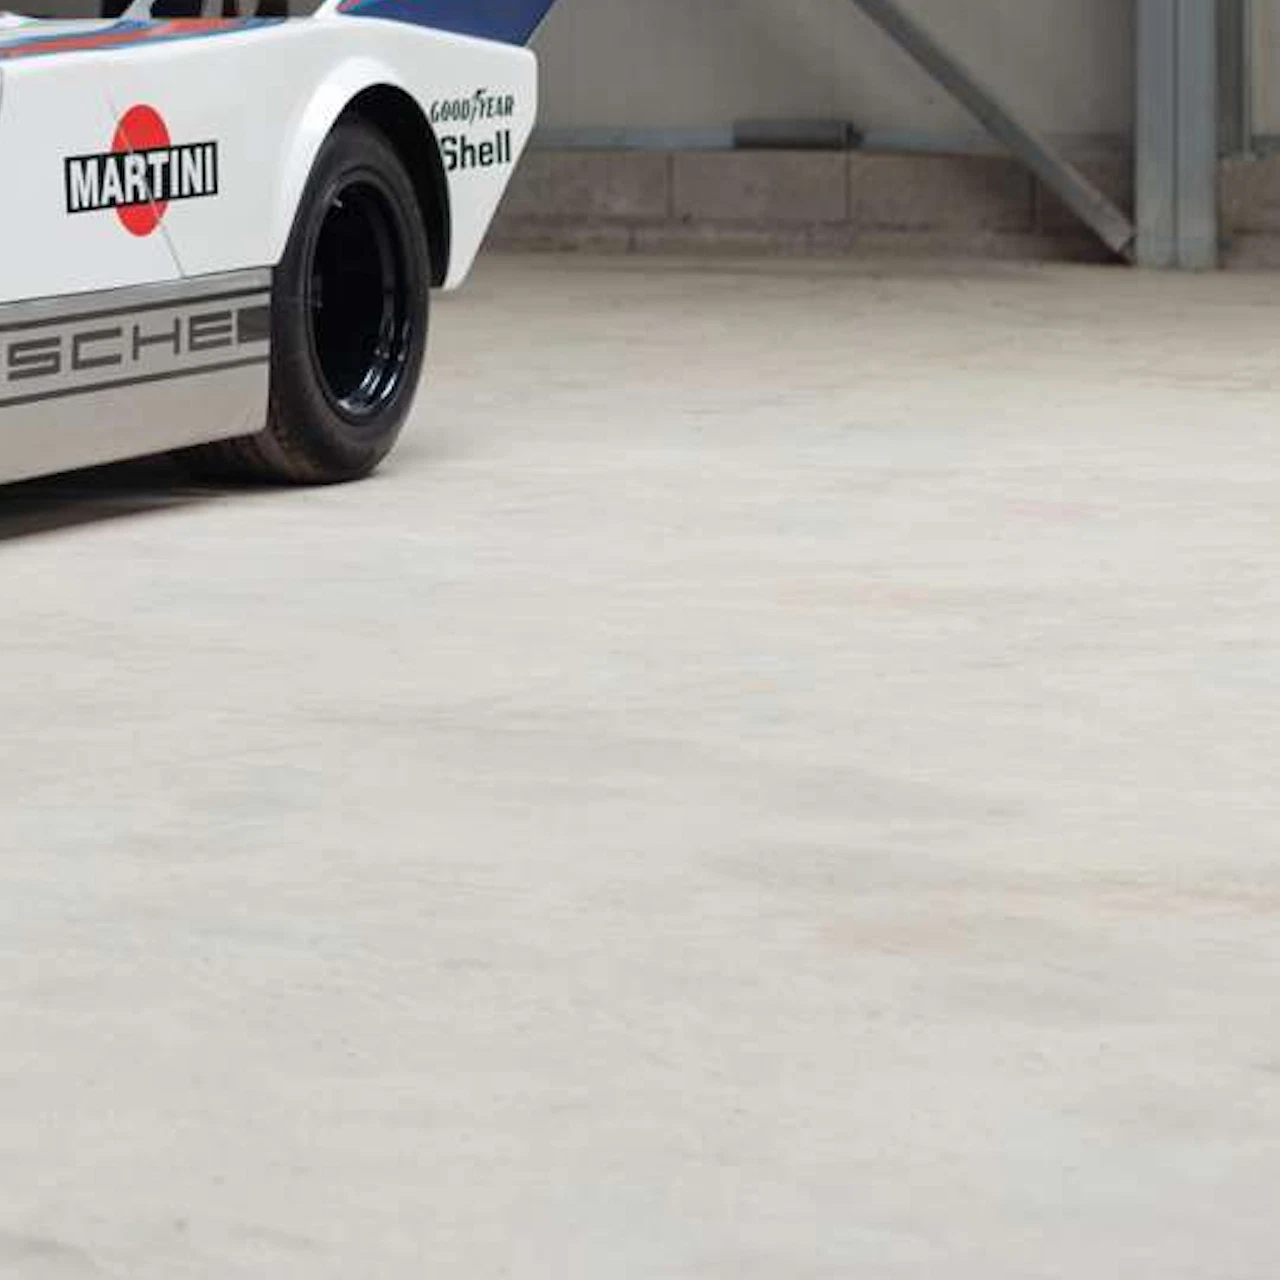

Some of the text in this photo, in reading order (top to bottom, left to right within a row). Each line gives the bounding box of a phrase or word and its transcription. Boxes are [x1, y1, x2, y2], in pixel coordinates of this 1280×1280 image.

[430, 88, 515, 125] GOODYEAR
[440, 130, 511, 170] Shell
[67, 143, 215, 211] MARTINI
